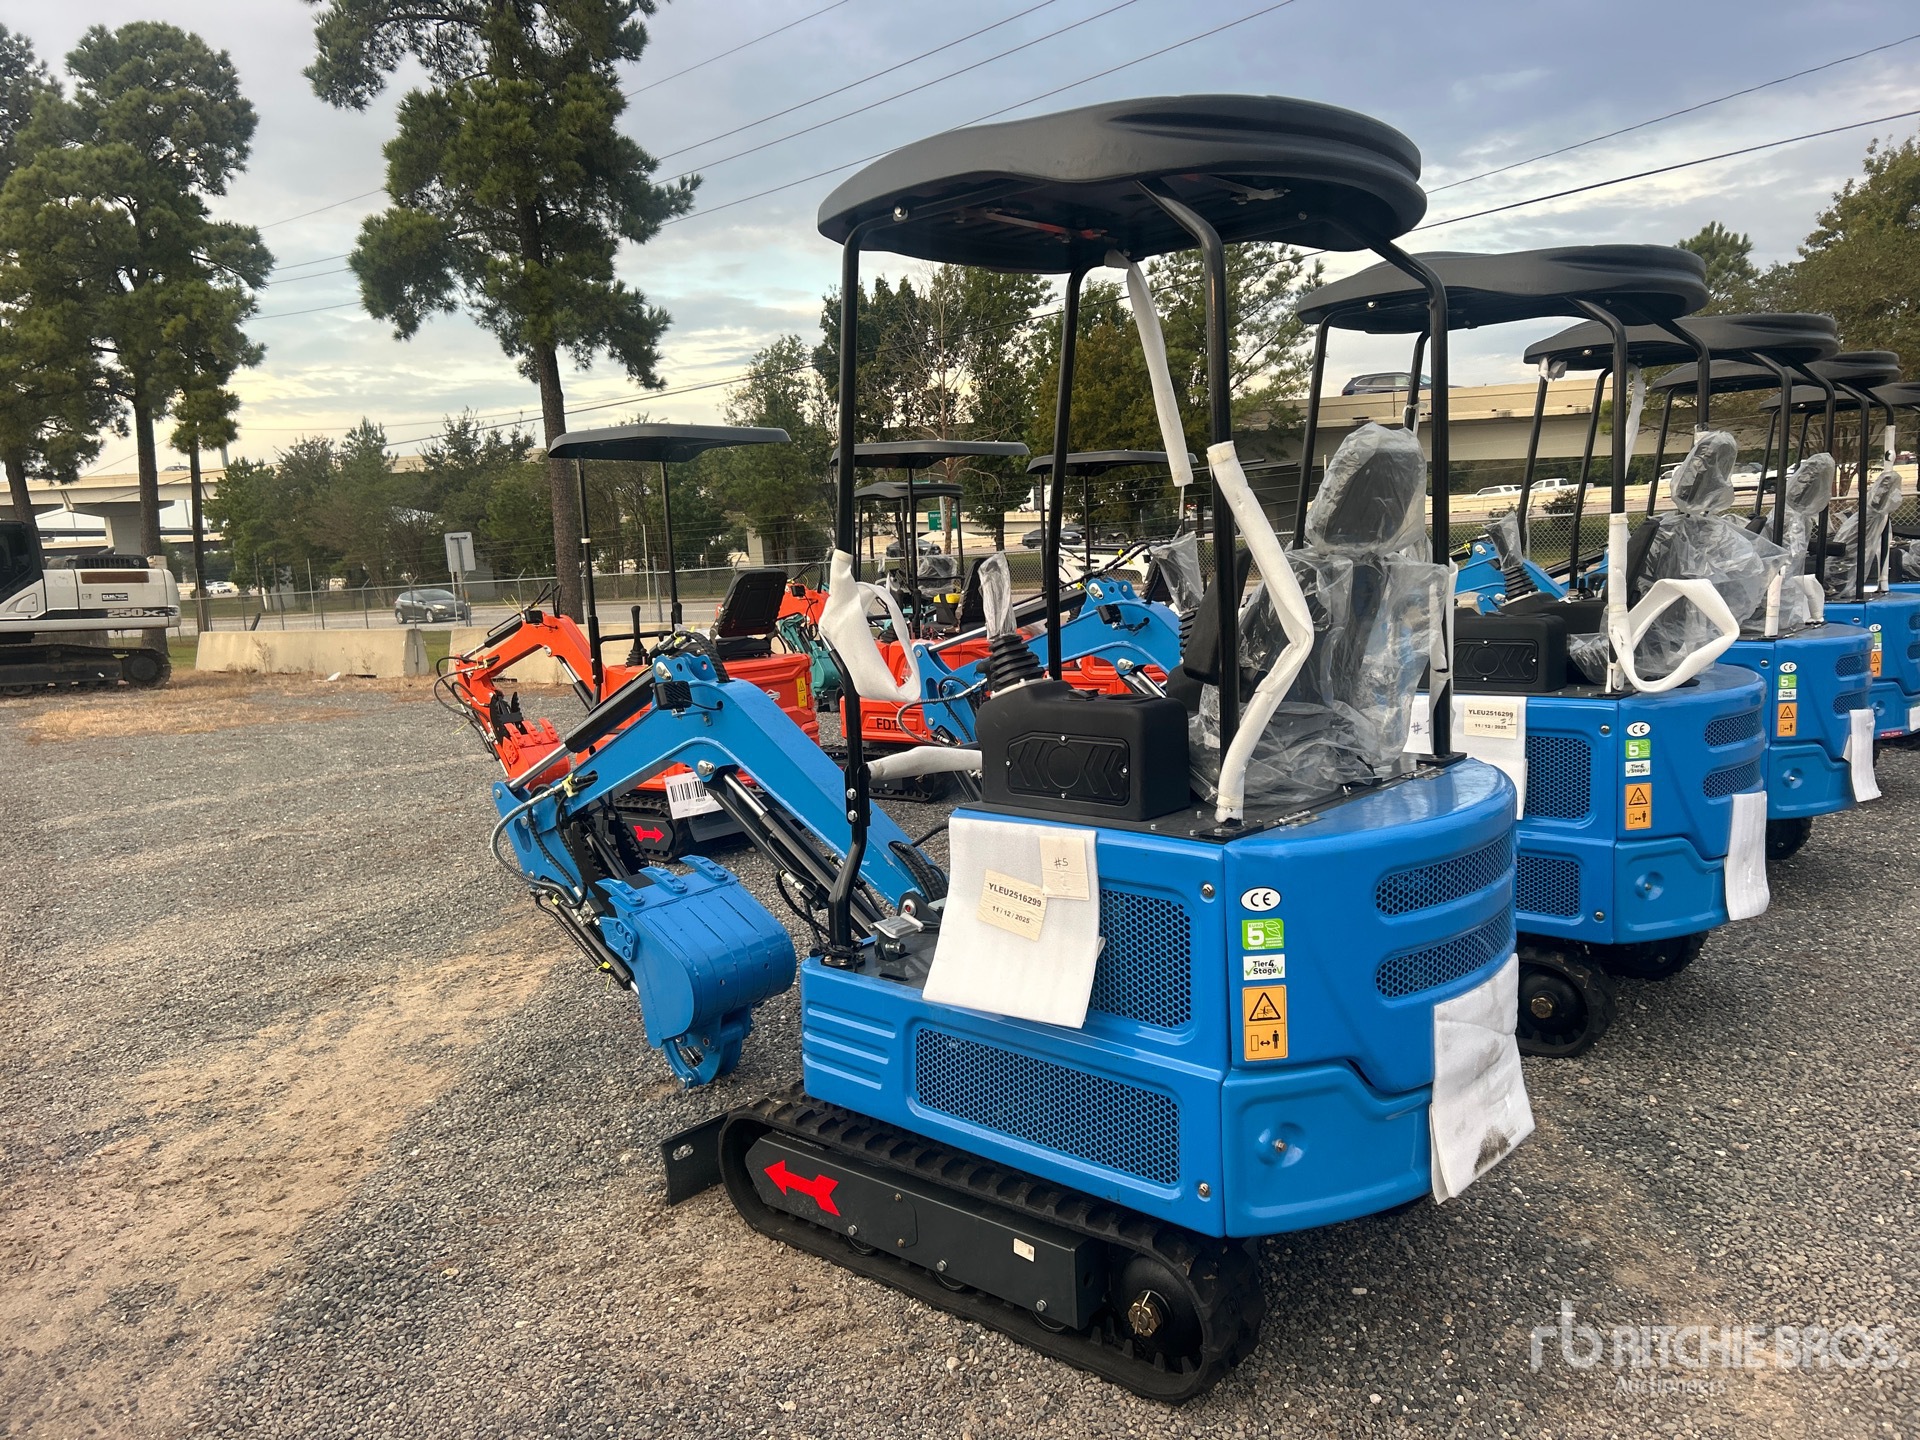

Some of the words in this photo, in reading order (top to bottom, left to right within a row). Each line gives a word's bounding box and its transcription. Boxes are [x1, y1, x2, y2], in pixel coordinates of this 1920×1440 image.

[1632, 724, 1645, 734] CE
[1053, 857, 1069, 869] #5
[988, 882, 1042, 907] YLEU2516299
[1250, 891, 1271, 907] CE
[1247, 925, 1265, 946] 5
